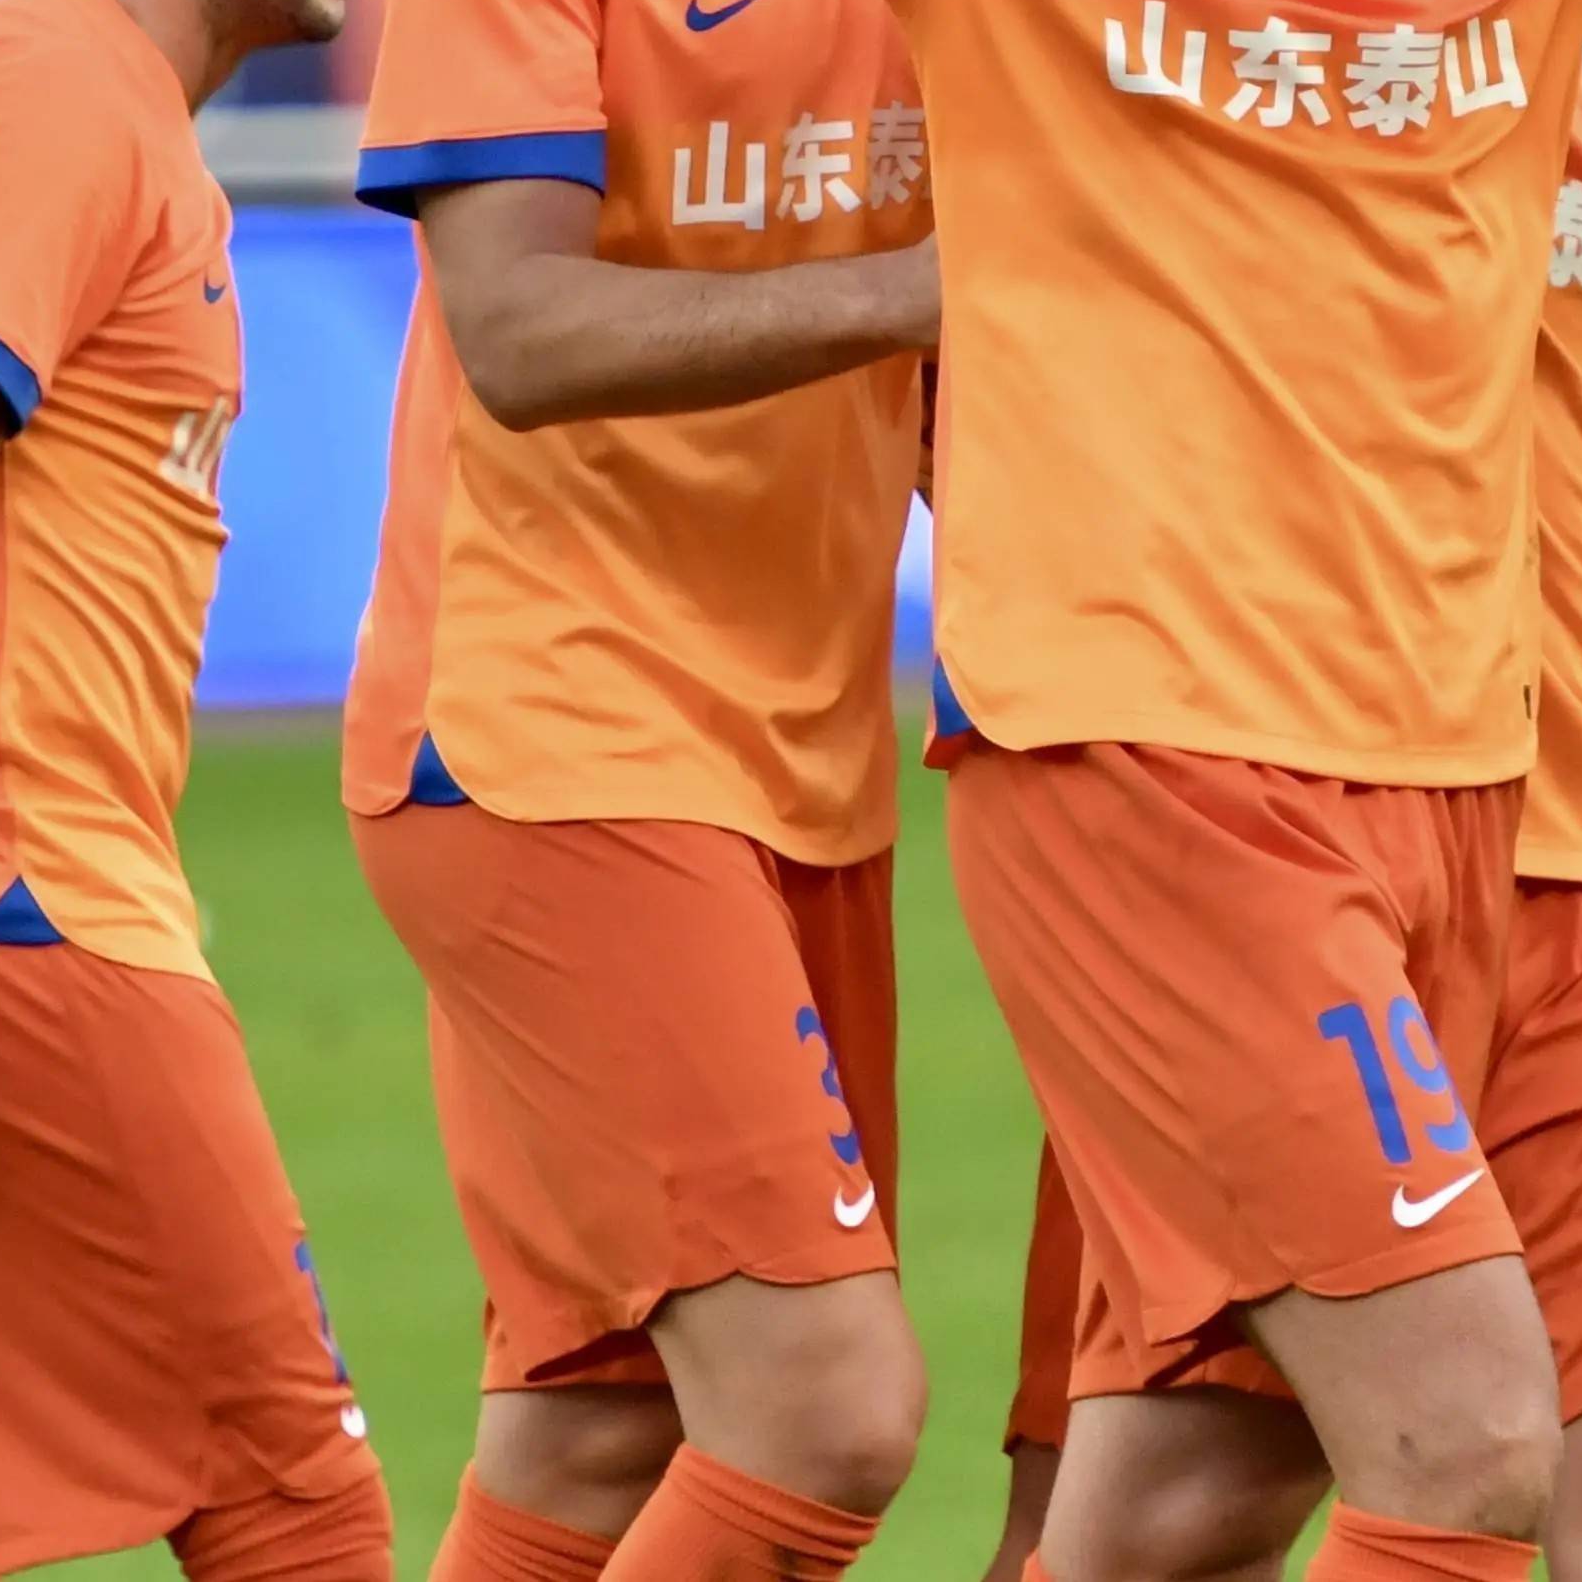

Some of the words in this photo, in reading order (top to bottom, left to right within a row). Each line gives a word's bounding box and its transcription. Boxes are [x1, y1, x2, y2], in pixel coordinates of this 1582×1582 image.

[1104, 0, 1529, 136] 山东泰山
[1316, 995, 1472, 1164] 19
